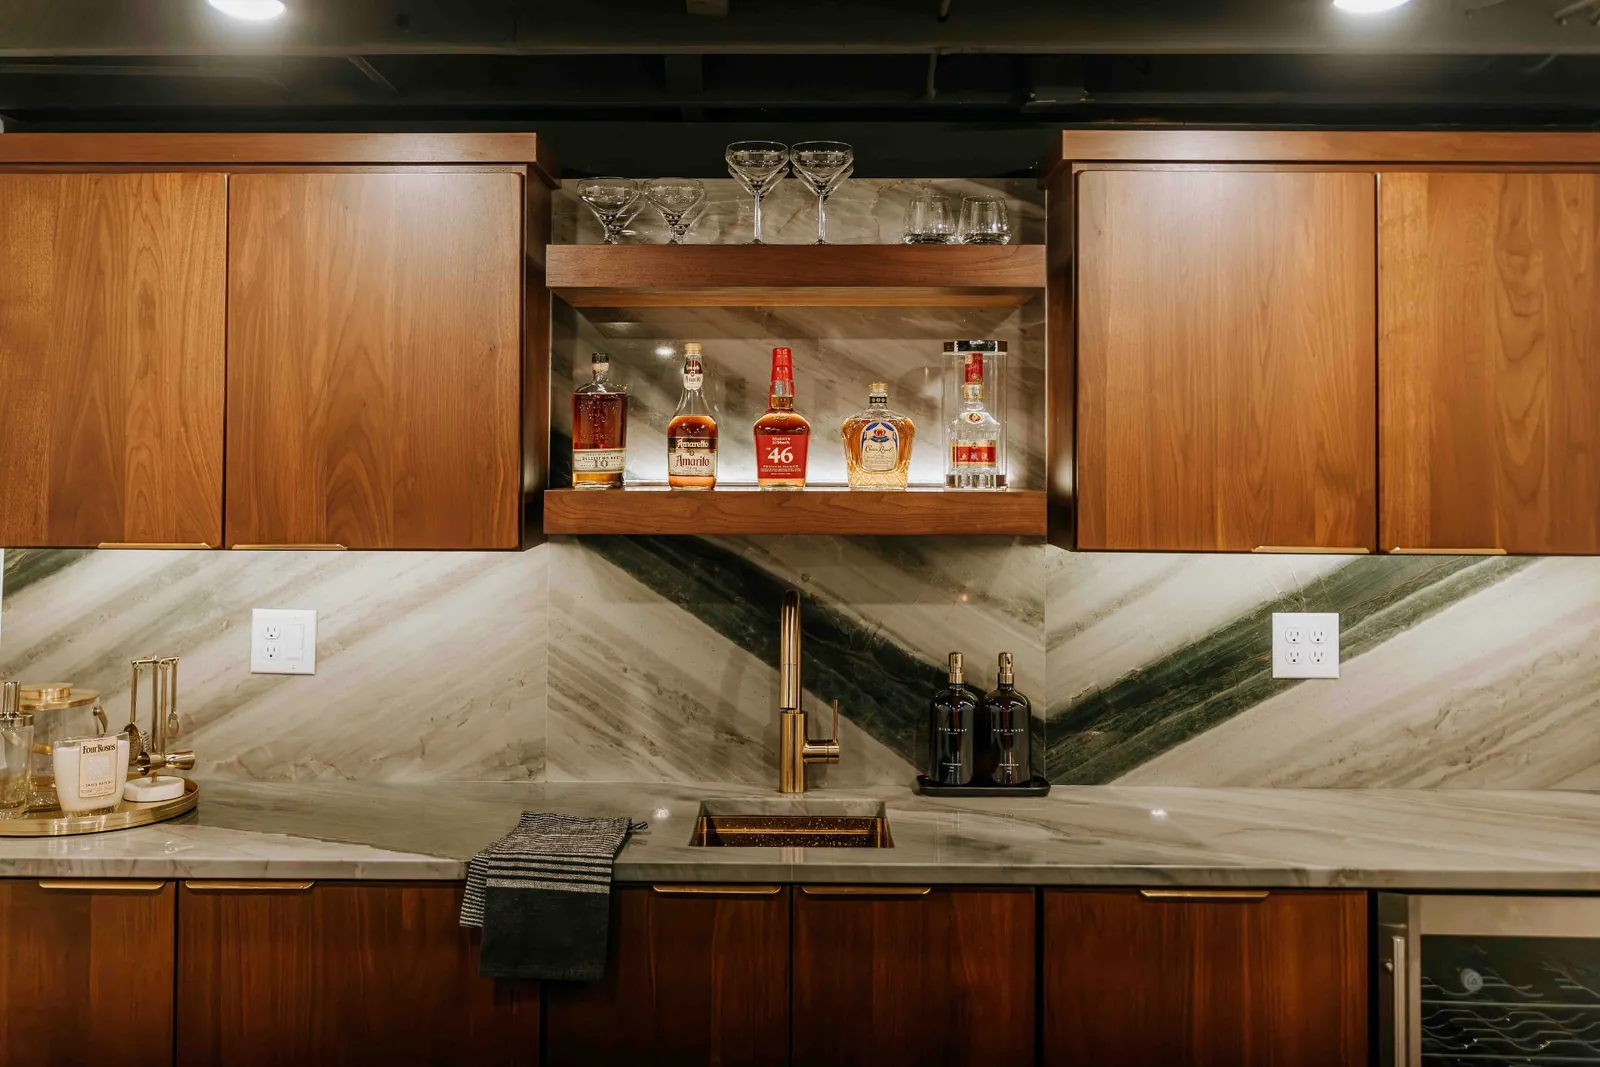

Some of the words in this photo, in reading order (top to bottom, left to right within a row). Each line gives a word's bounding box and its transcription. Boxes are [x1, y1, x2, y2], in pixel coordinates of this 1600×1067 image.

[677, 438, 709, 449] Amaretto
[767, 446, 794, 464] 46
[594, 459, 608, 468] 10
[82, 745, 97, 754] Four
[97, 744, 115, 752] Roses
